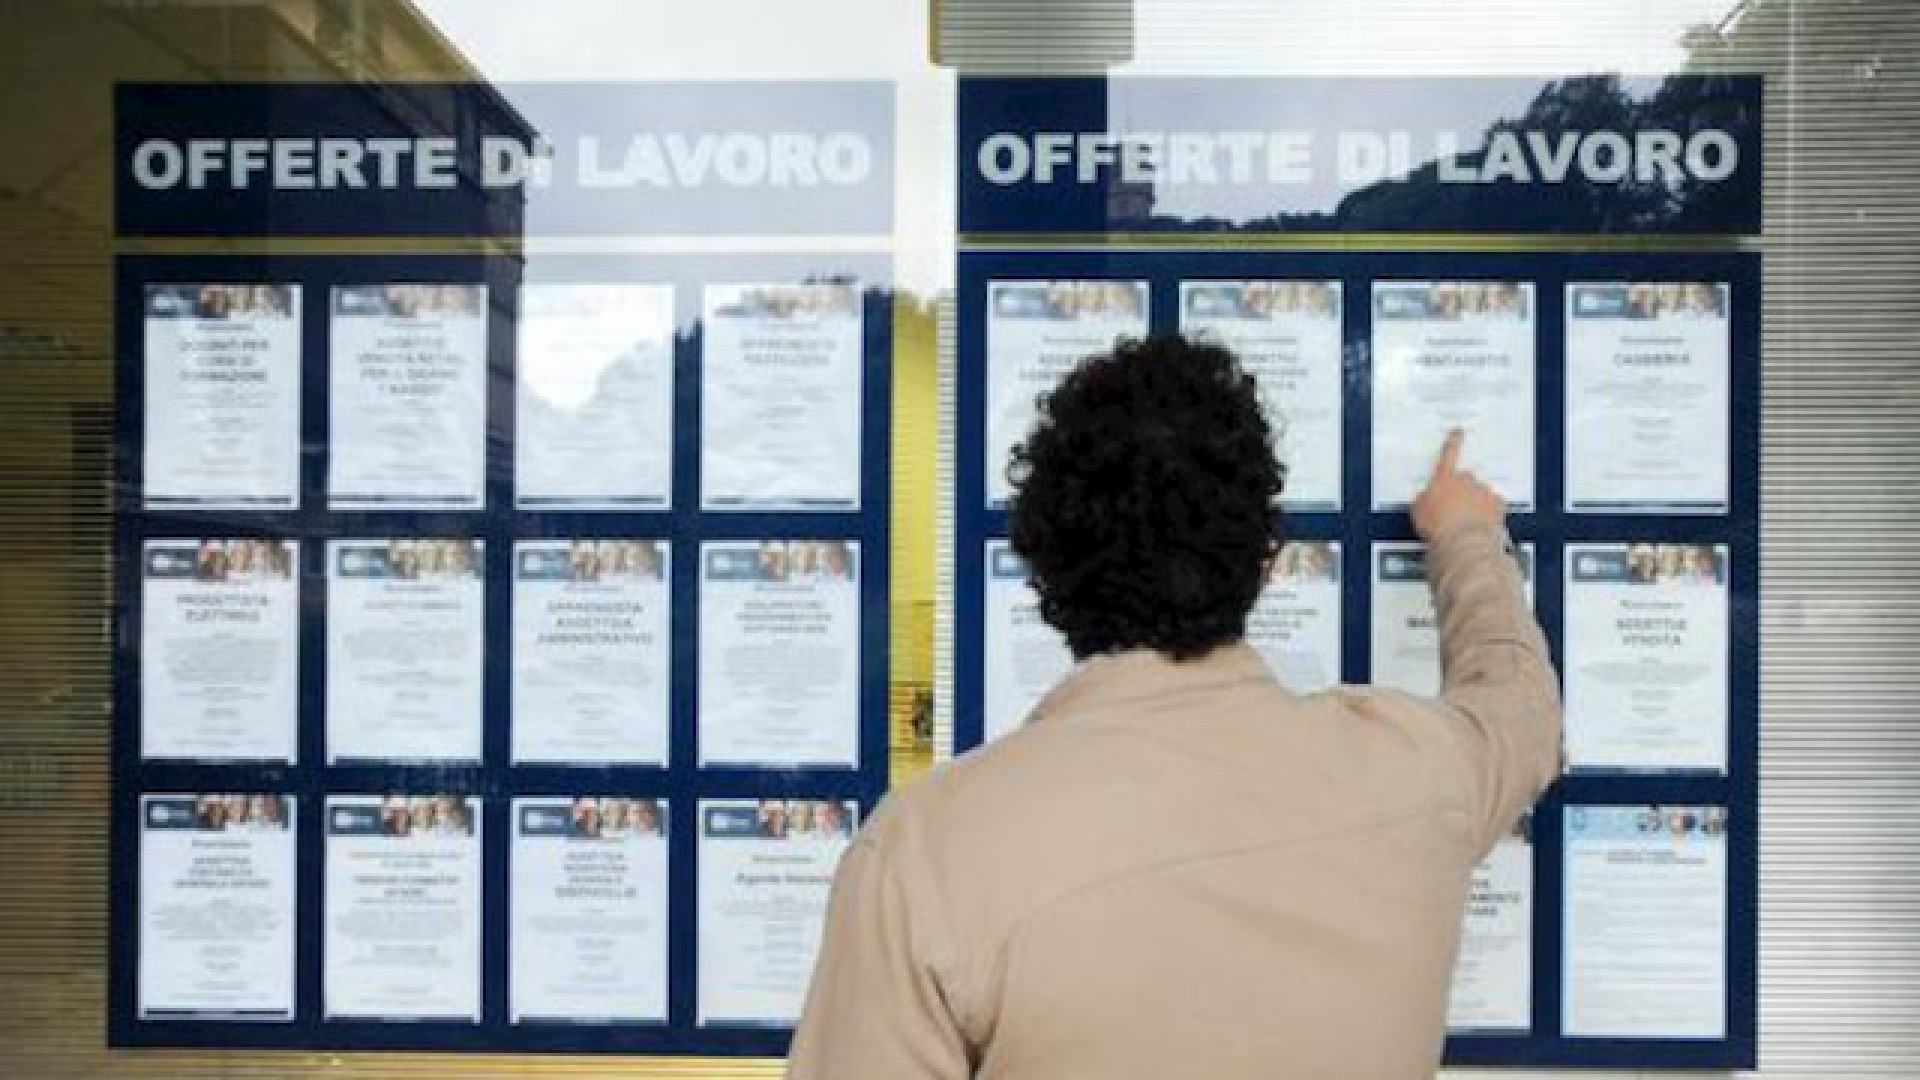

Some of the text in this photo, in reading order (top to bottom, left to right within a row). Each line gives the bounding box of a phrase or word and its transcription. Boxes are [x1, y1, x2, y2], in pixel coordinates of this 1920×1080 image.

[132, 132, 872, 190] OFFERTE DI LAVORO
[977, 129, 1739, 186] OFFERTE DI LAVORO
